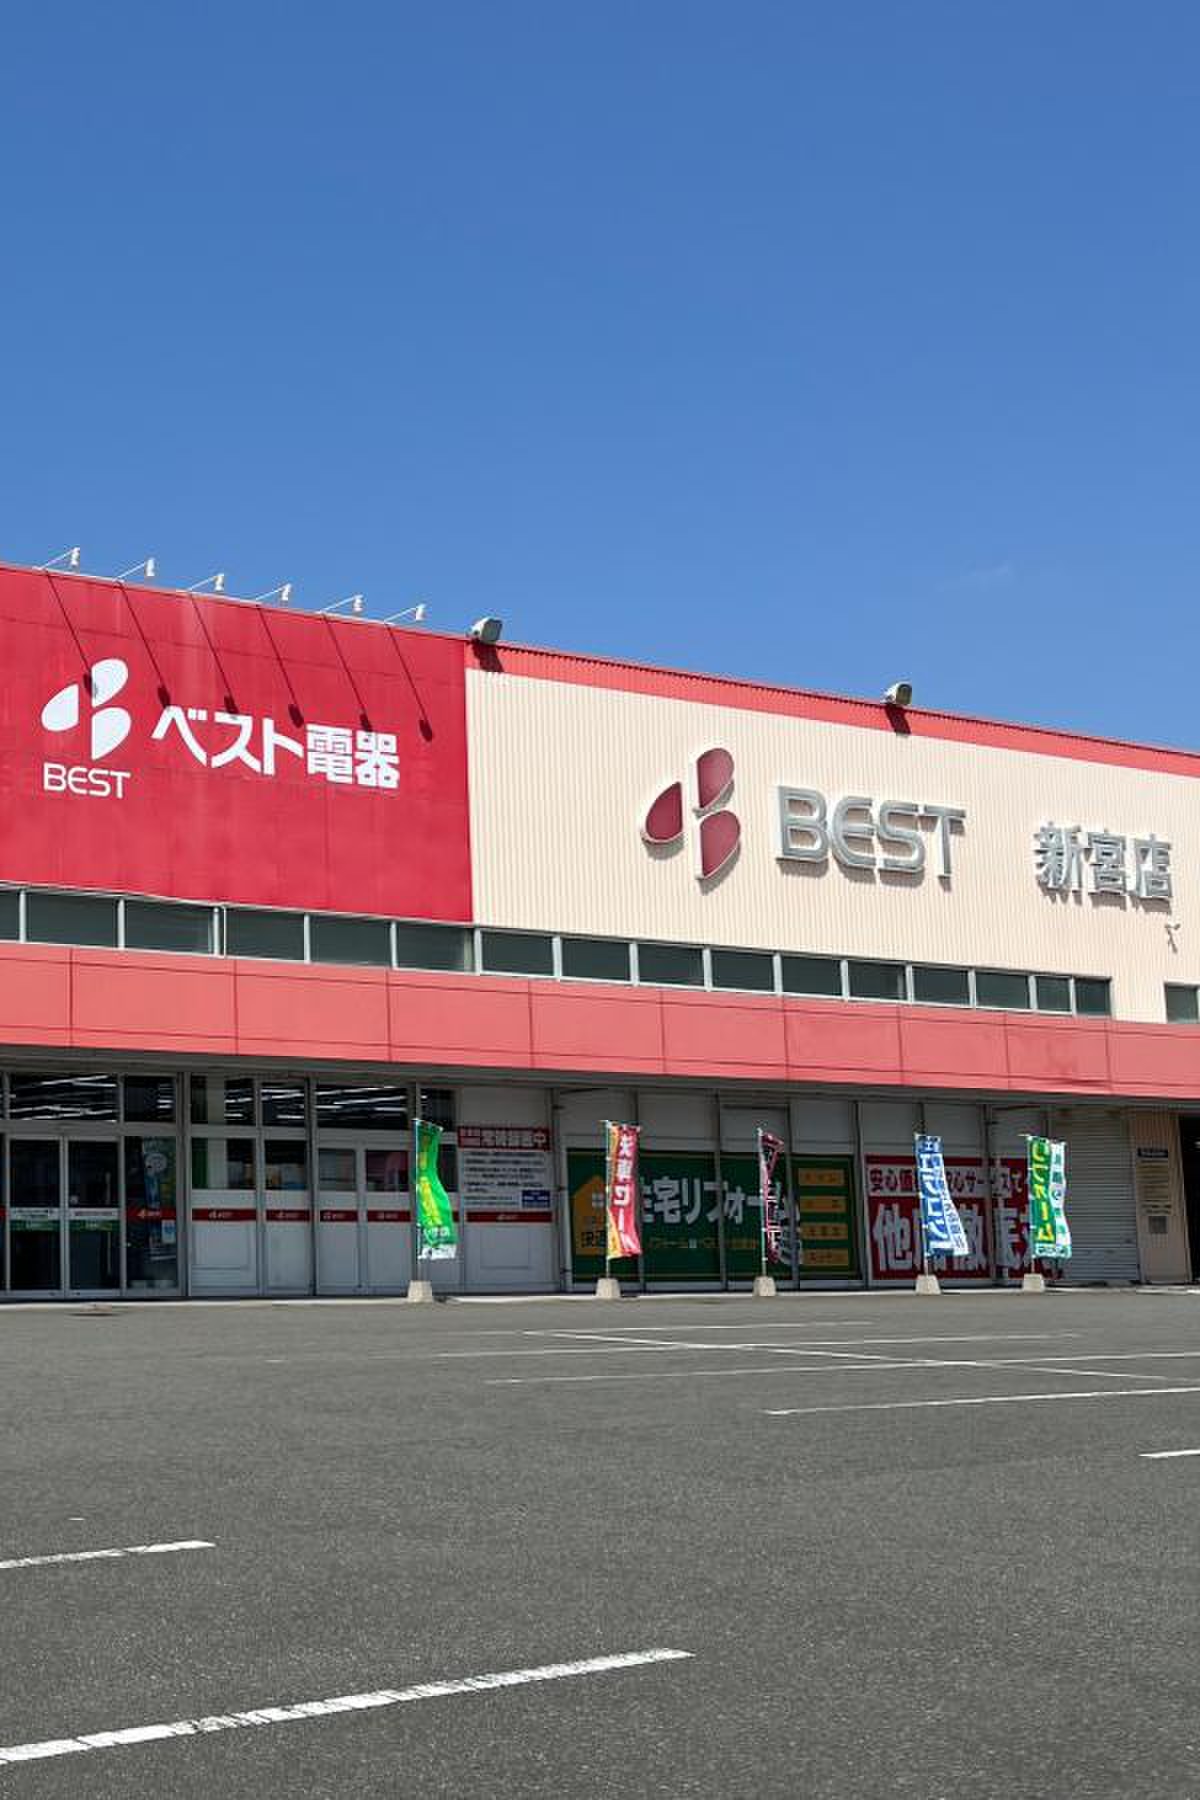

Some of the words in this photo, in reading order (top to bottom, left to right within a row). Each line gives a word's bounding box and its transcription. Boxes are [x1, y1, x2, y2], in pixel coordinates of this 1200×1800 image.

[43, 762, 131, 799] BEST
[151, 704, 400, 789] ベスト電器
[776, 785, 967, 878] BEST
[1034, 821, 1174, 900] 新宮店
